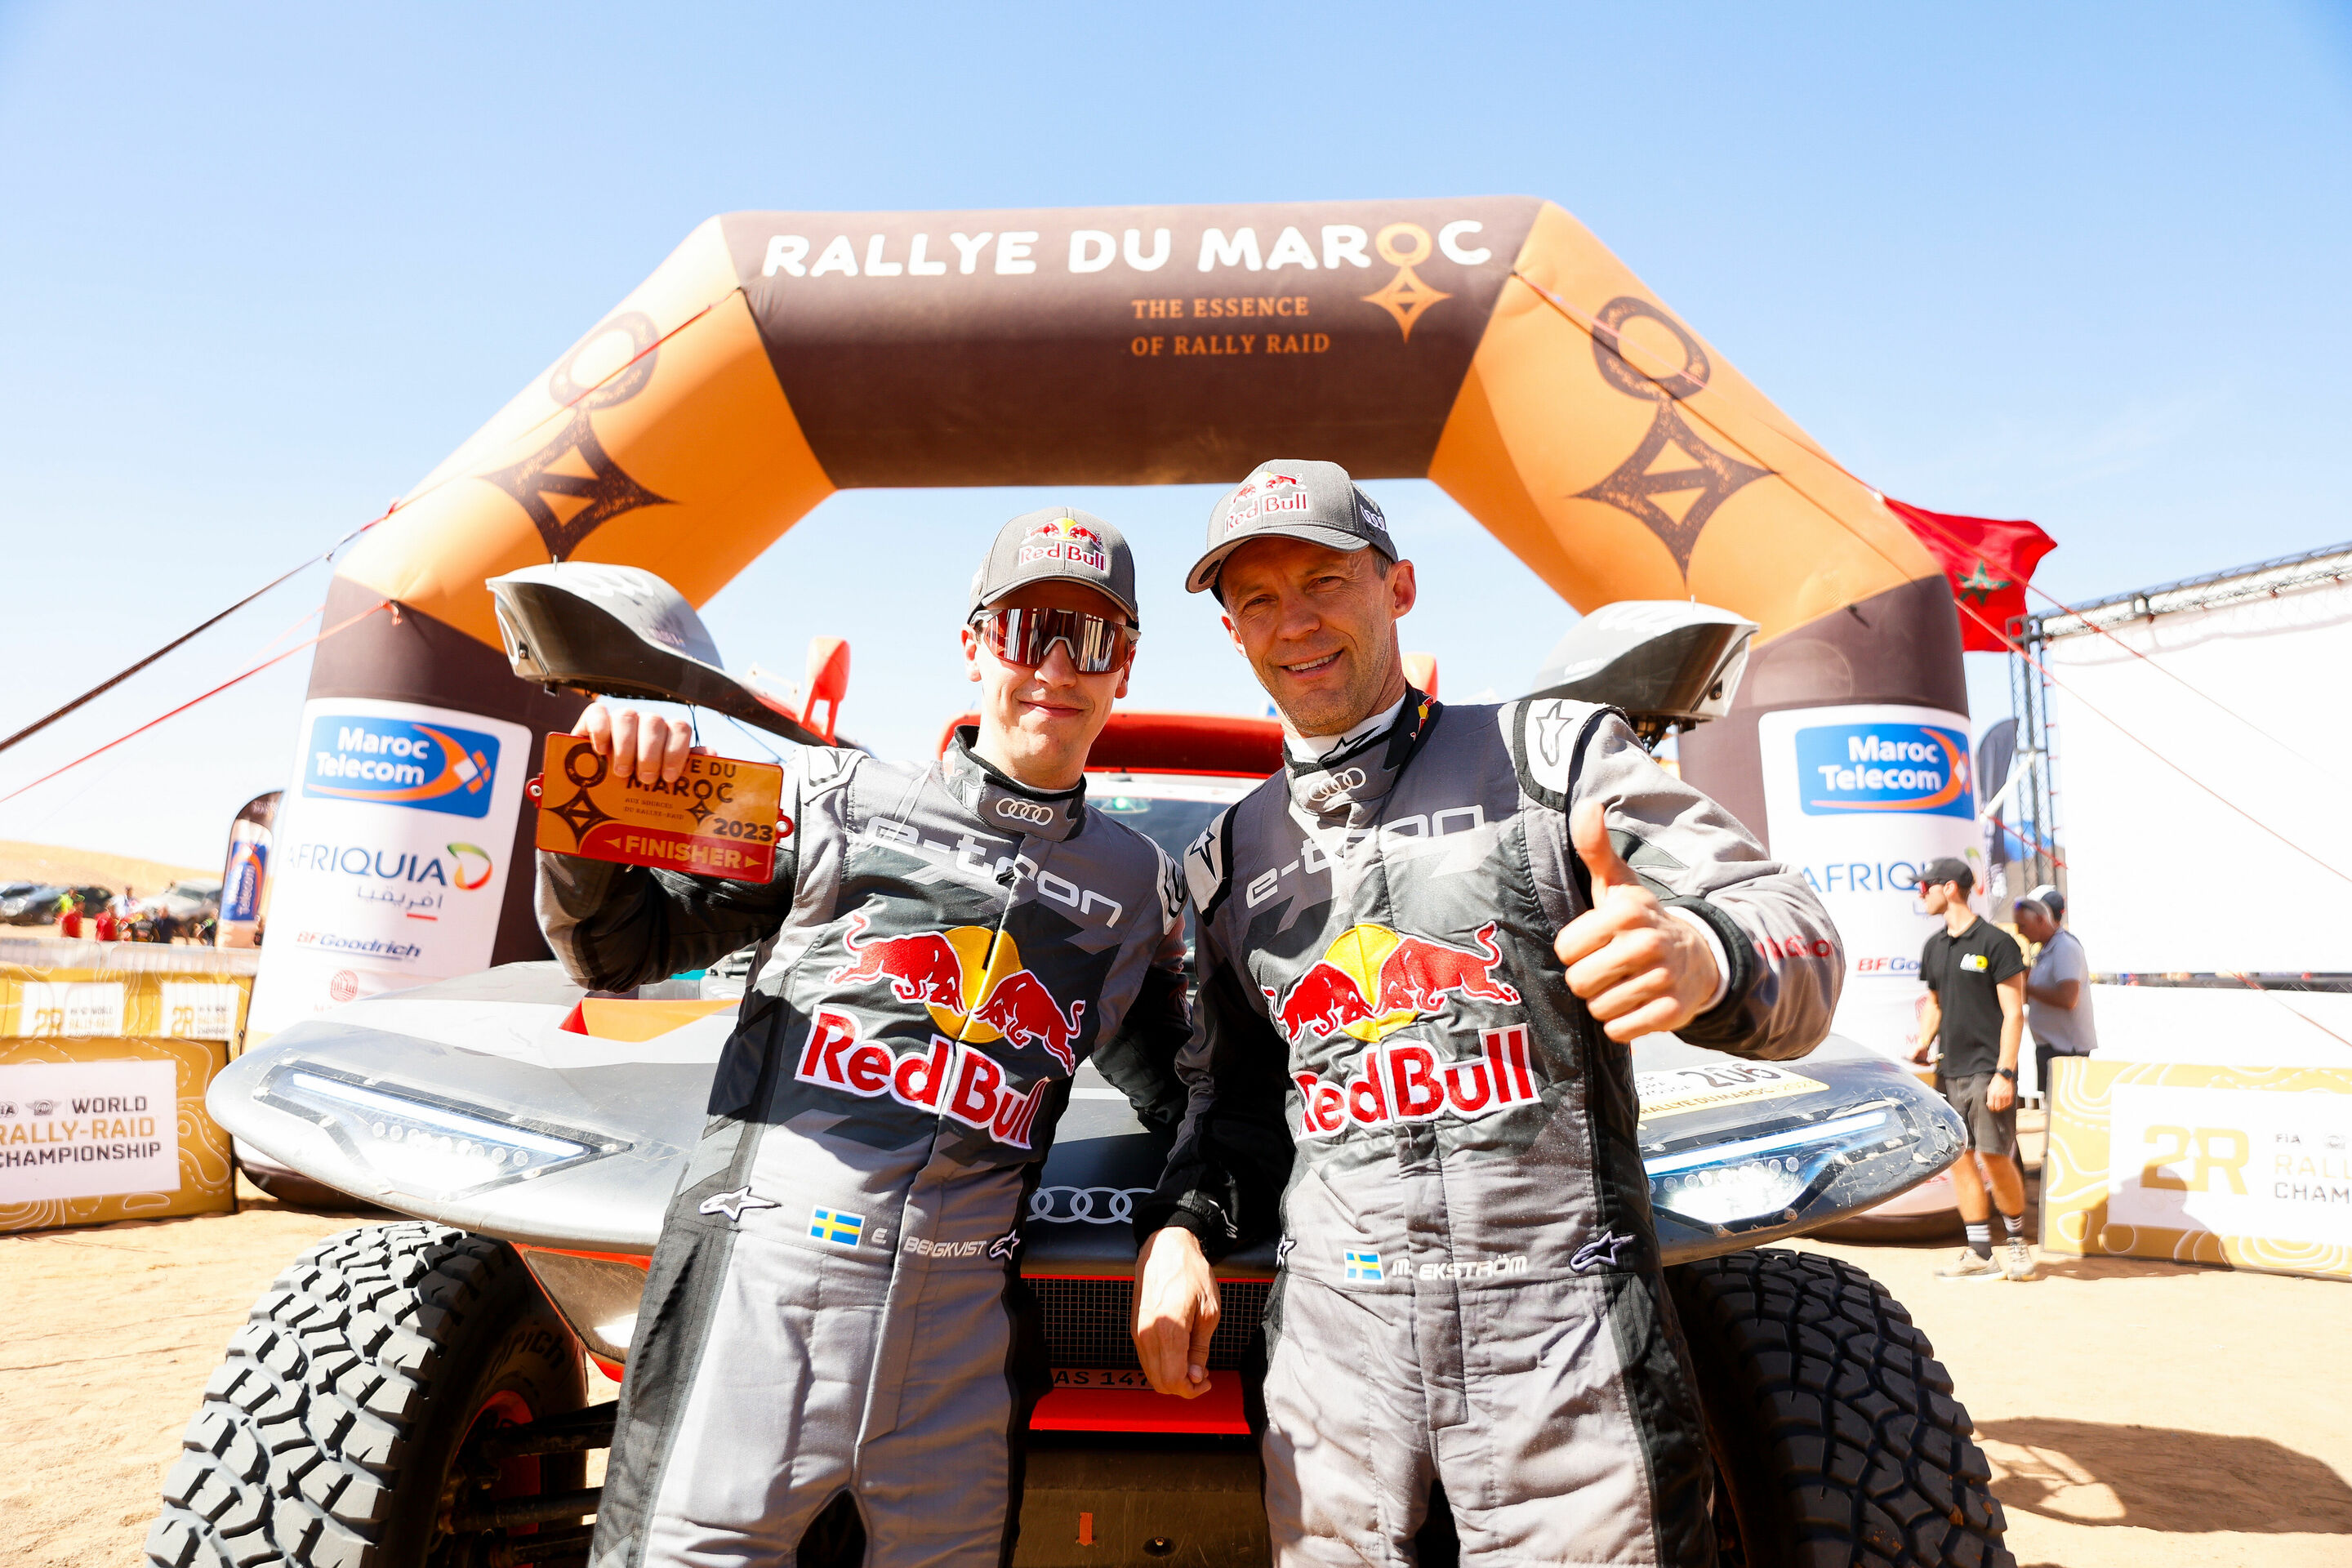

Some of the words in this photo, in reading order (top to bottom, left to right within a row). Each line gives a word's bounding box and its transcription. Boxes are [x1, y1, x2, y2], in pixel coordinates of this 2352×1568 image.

[761, 231, 1039, 277] RALLYE
[1068, 228, 1170, 273] DU
[1198, 220, 1491, 272] MAROC
[1132, 299, 1183, 319] THE
[1193, 296, 1309, 318] ESSENCE
[1132, 336, 1164, 356] OF
[1174, 335, 1256, 356] RALLY
[1265, 333, 1330, 354] RAID
[1226, 503, 1258, 532] Red
[1266, 493, 1307, 513] Bull
[1020, 542, 1061, 565] Red
[1066, 543, 1107, 571] Bull
[337, 727, 430, 760] Maroc
[1847, 736, 1940, 764] Maroc
[316, 752, 425, 785] Telecom
[710, 762, 736, 777] DU
[1818, 765, 1942, 791] Telecom
[626, 774, 733, 803] MAROC
[715, 817, 773, 842] 2023
[289, 844, 448, 887] AFRIQUIA
[625, 835, 742, 869] FINISHER
[1802, 861, 1926, 893] AFRIQ
[799, 1008, 952, 1110] Red
[947, 1046, 1049, 1146] Bull
[1388, 1027, 1537, 1120] Bull
[72, 1096, 148, 1116] WORLD
[903, 1236, 987, 1257] BERGKVIST
[1419, 1254, 1528, 1281] EKSTRÖM
[1054, 1370, 1089, 1384] AS
